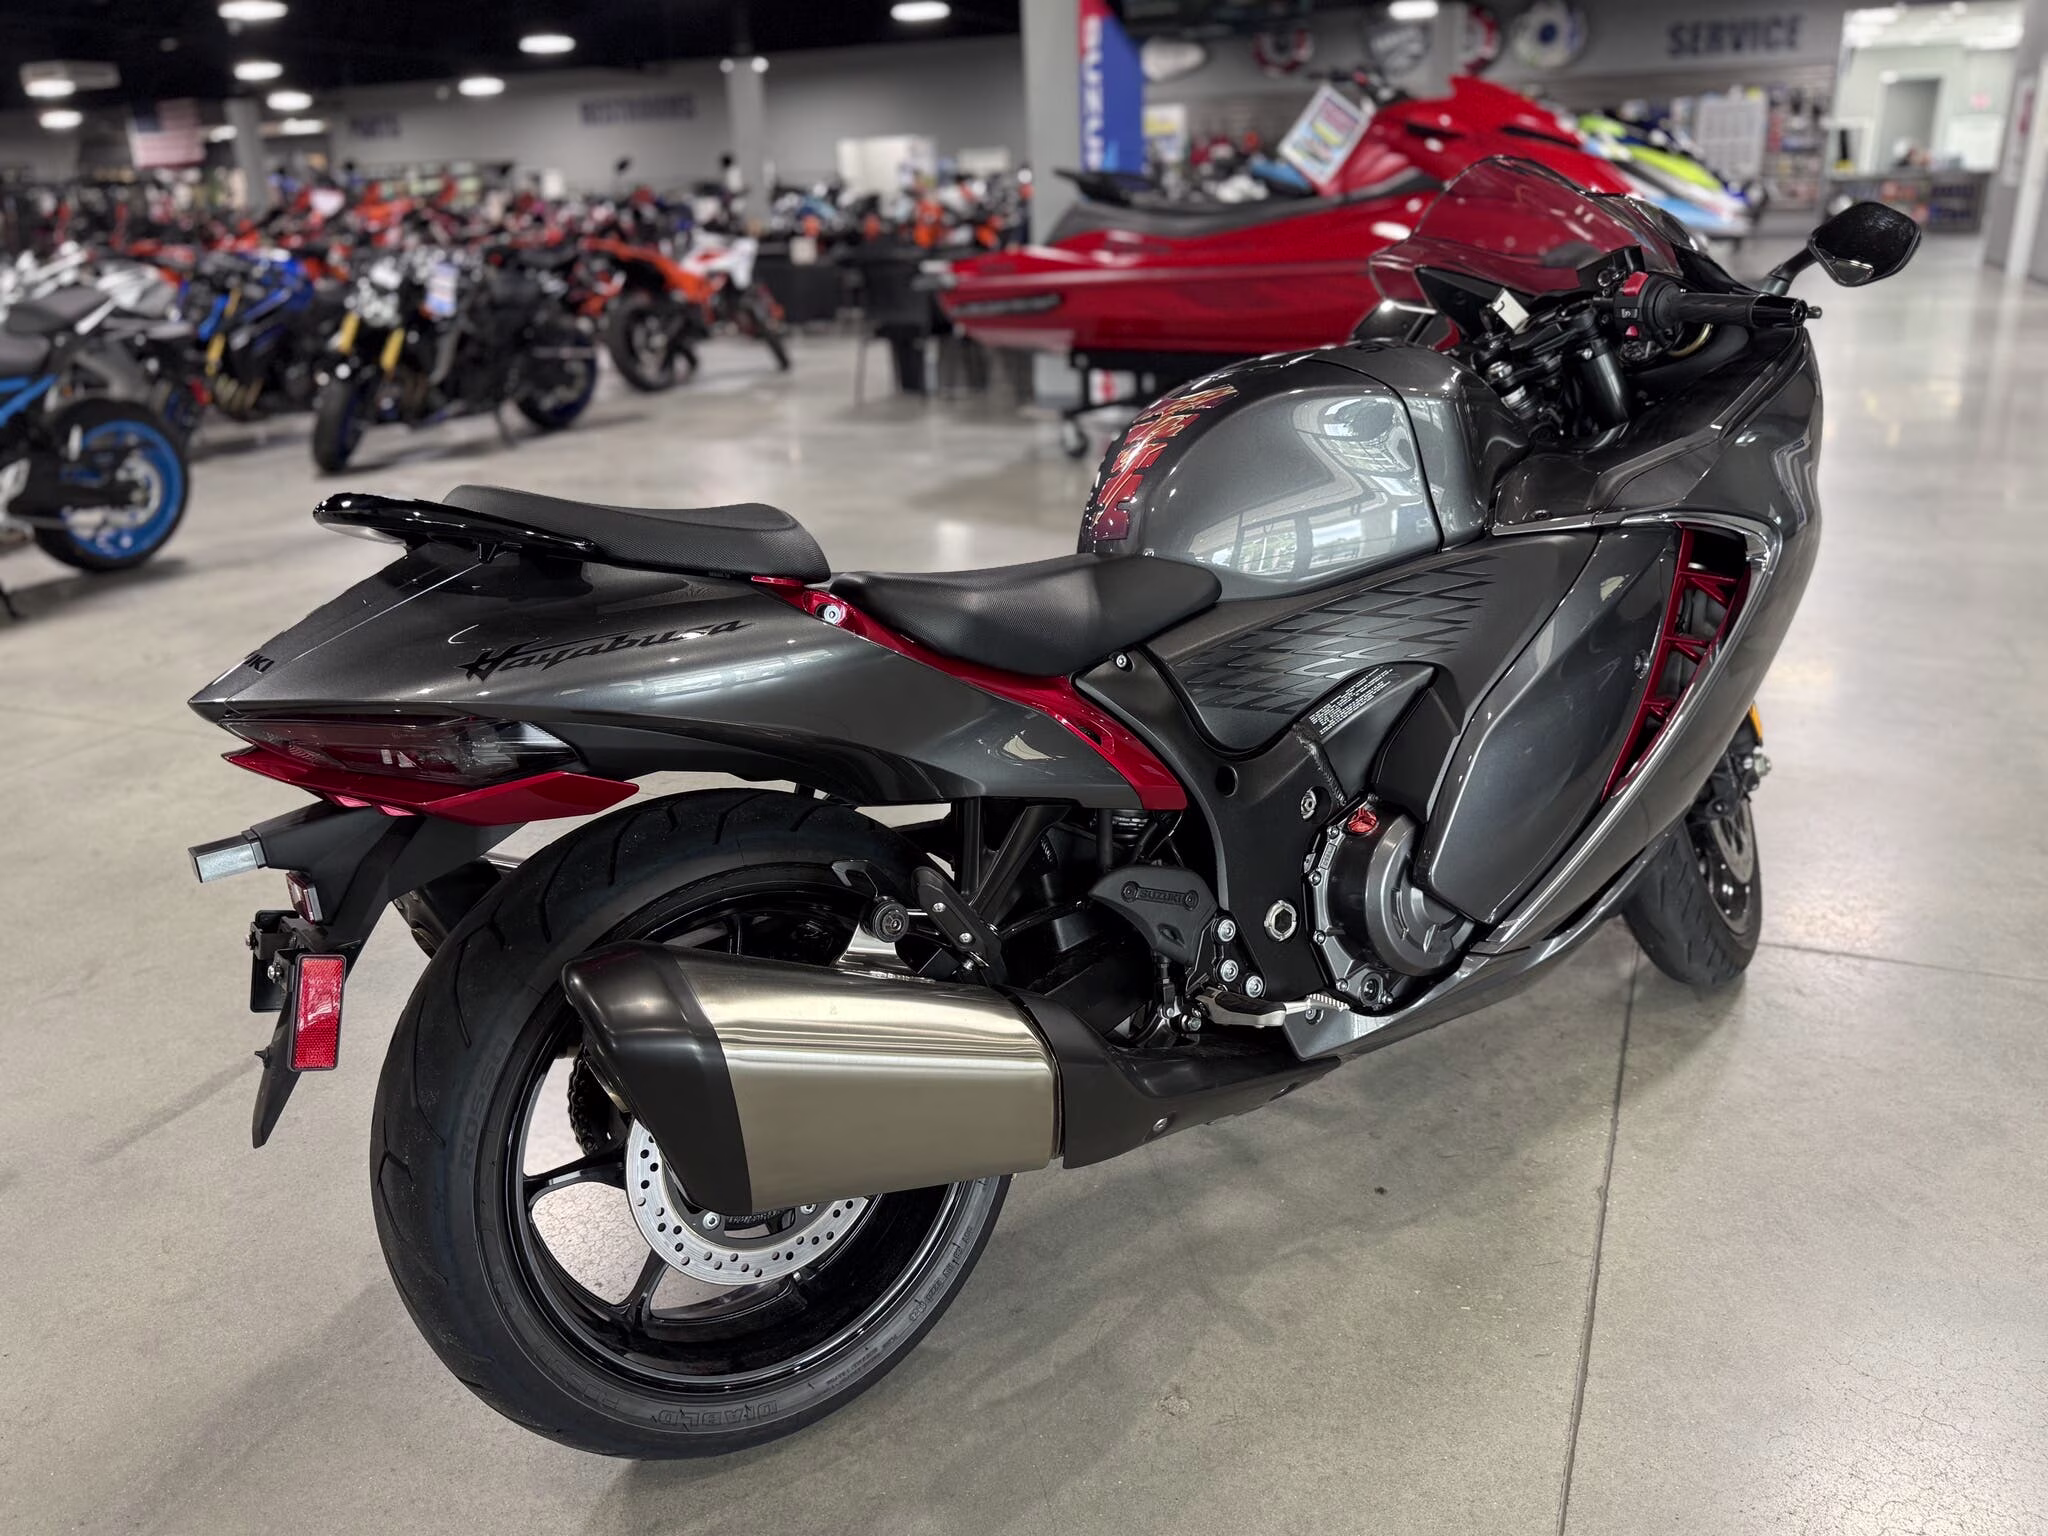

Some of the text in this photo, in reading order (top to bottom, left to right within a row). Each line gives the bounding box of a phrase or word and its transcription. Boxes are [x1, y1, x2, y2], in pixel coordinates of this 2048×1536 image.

[1668, 15, 1803, 57] SERVICE
[455, 620, 755, 682] Hayabusa
[1139, 889, 1183, 904] SUZUKI
[658, 1400, 778, 1427] DIABLO
